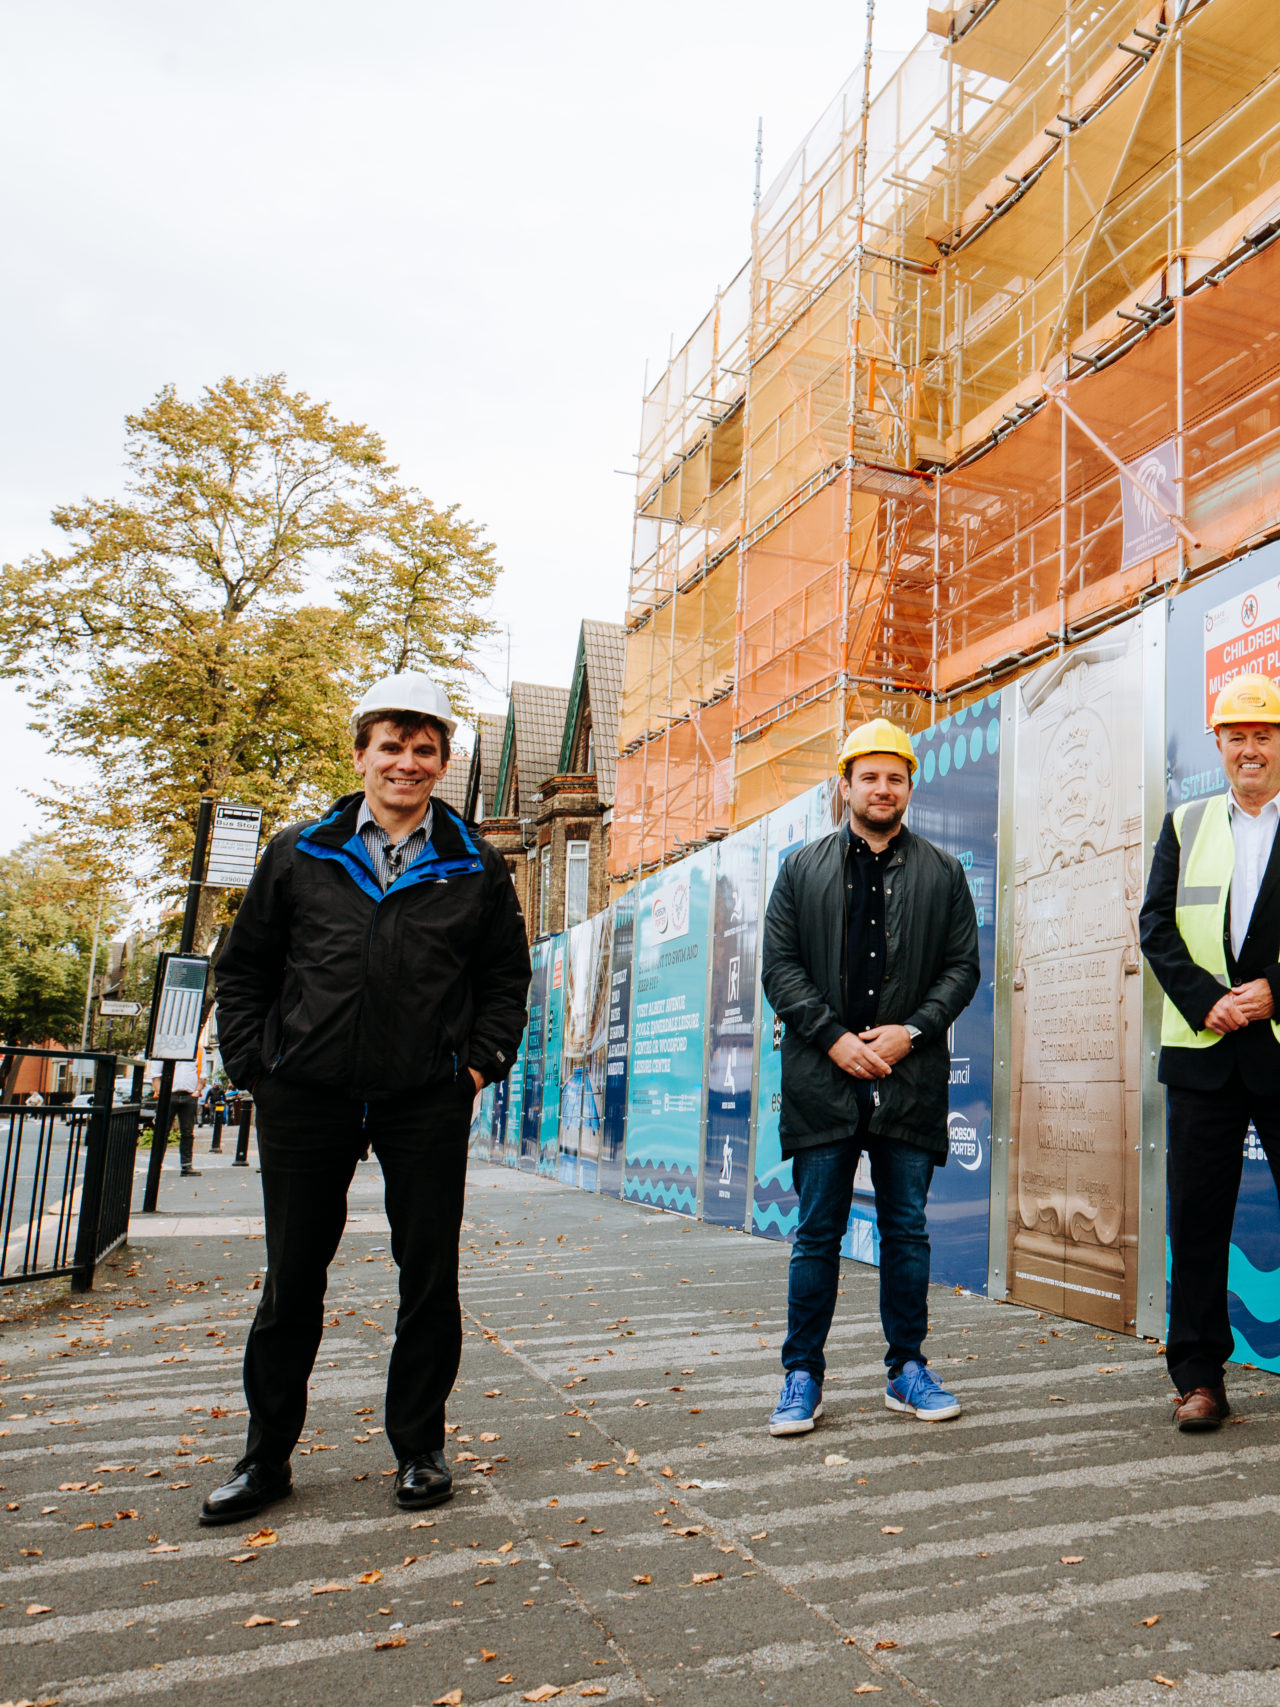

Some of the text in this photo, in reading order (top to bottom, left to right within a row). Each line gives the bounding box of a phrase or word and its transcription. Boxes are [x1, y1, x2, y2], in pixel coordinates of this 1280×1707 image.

[1223, 623, 1280, 664] CHILDREN
[1181, 768, 1225, 800] STILL
[216, 819, 258, 830] Bus Stop
[948, 1064, 970, 1084] ouncil
[949, 1127, 977, 1141] HOBSON
[950, 1142, 976, 1156] PORTER
